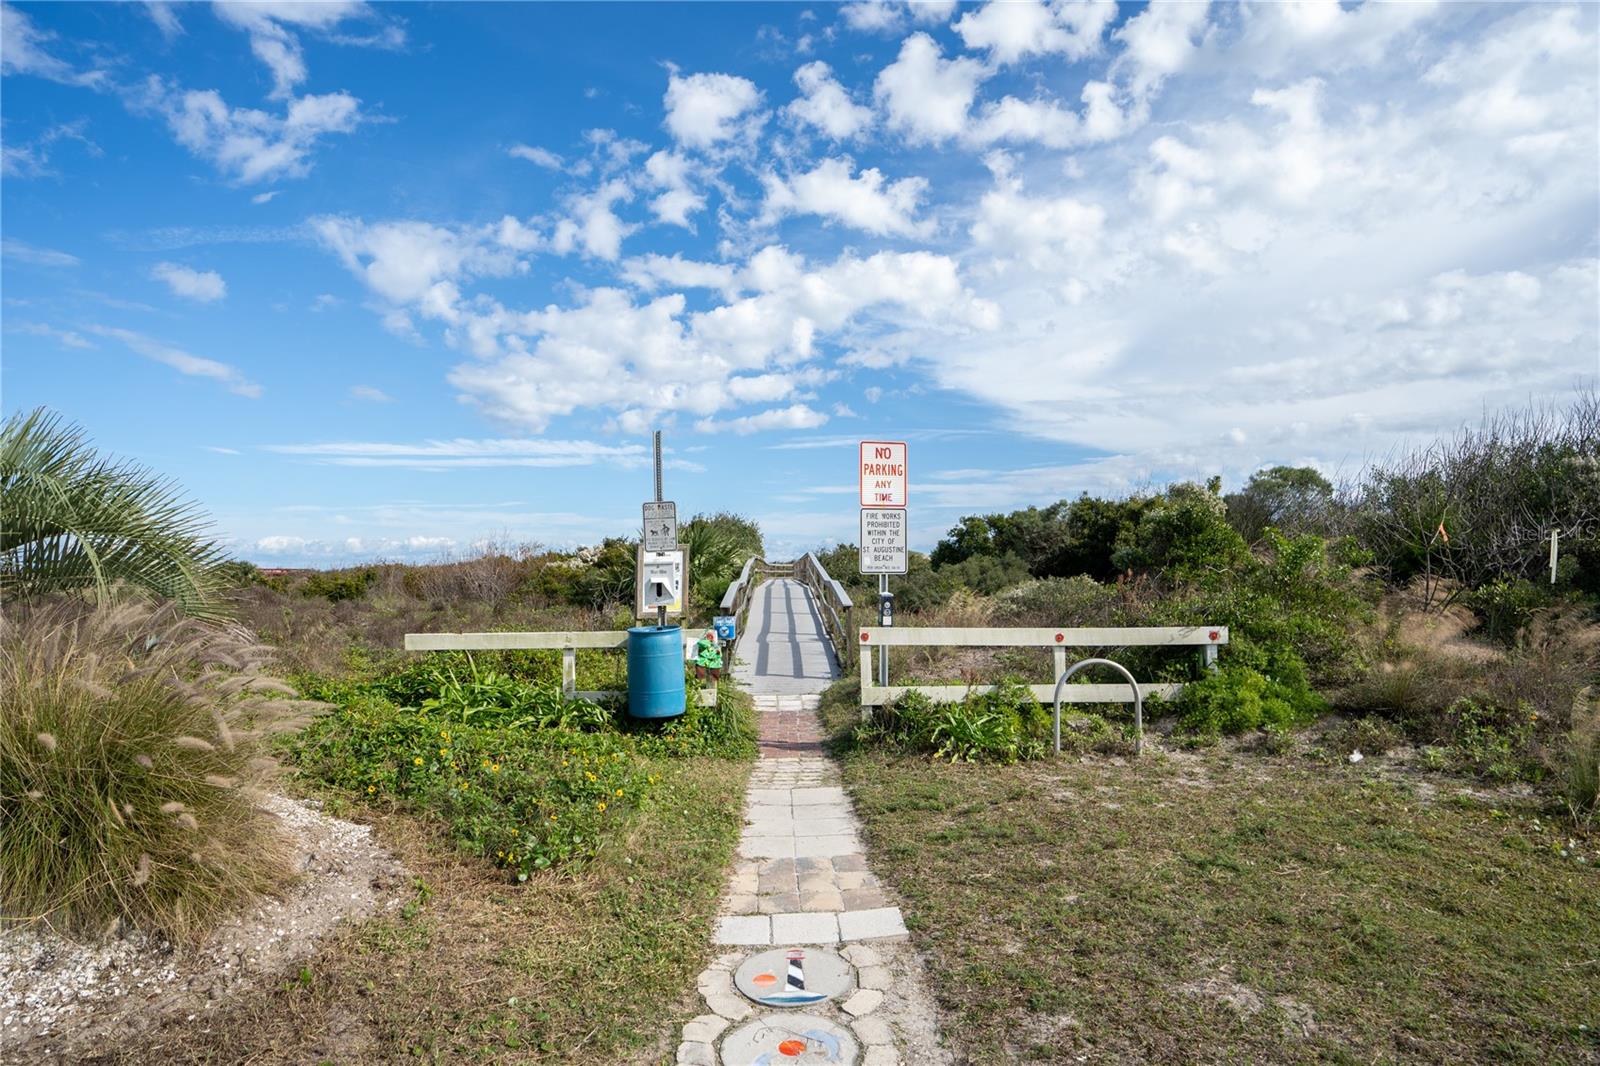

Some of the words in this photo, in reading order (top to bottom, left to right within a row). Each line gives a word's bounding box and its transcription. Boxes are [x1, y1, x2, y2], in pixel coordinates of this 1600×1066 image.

[875, 447, 892, 460] NO
[864, 464, 903, 476] PARKING
[874, 480, 892, 488] ANY
[874, 493, 892, 502] TIME
